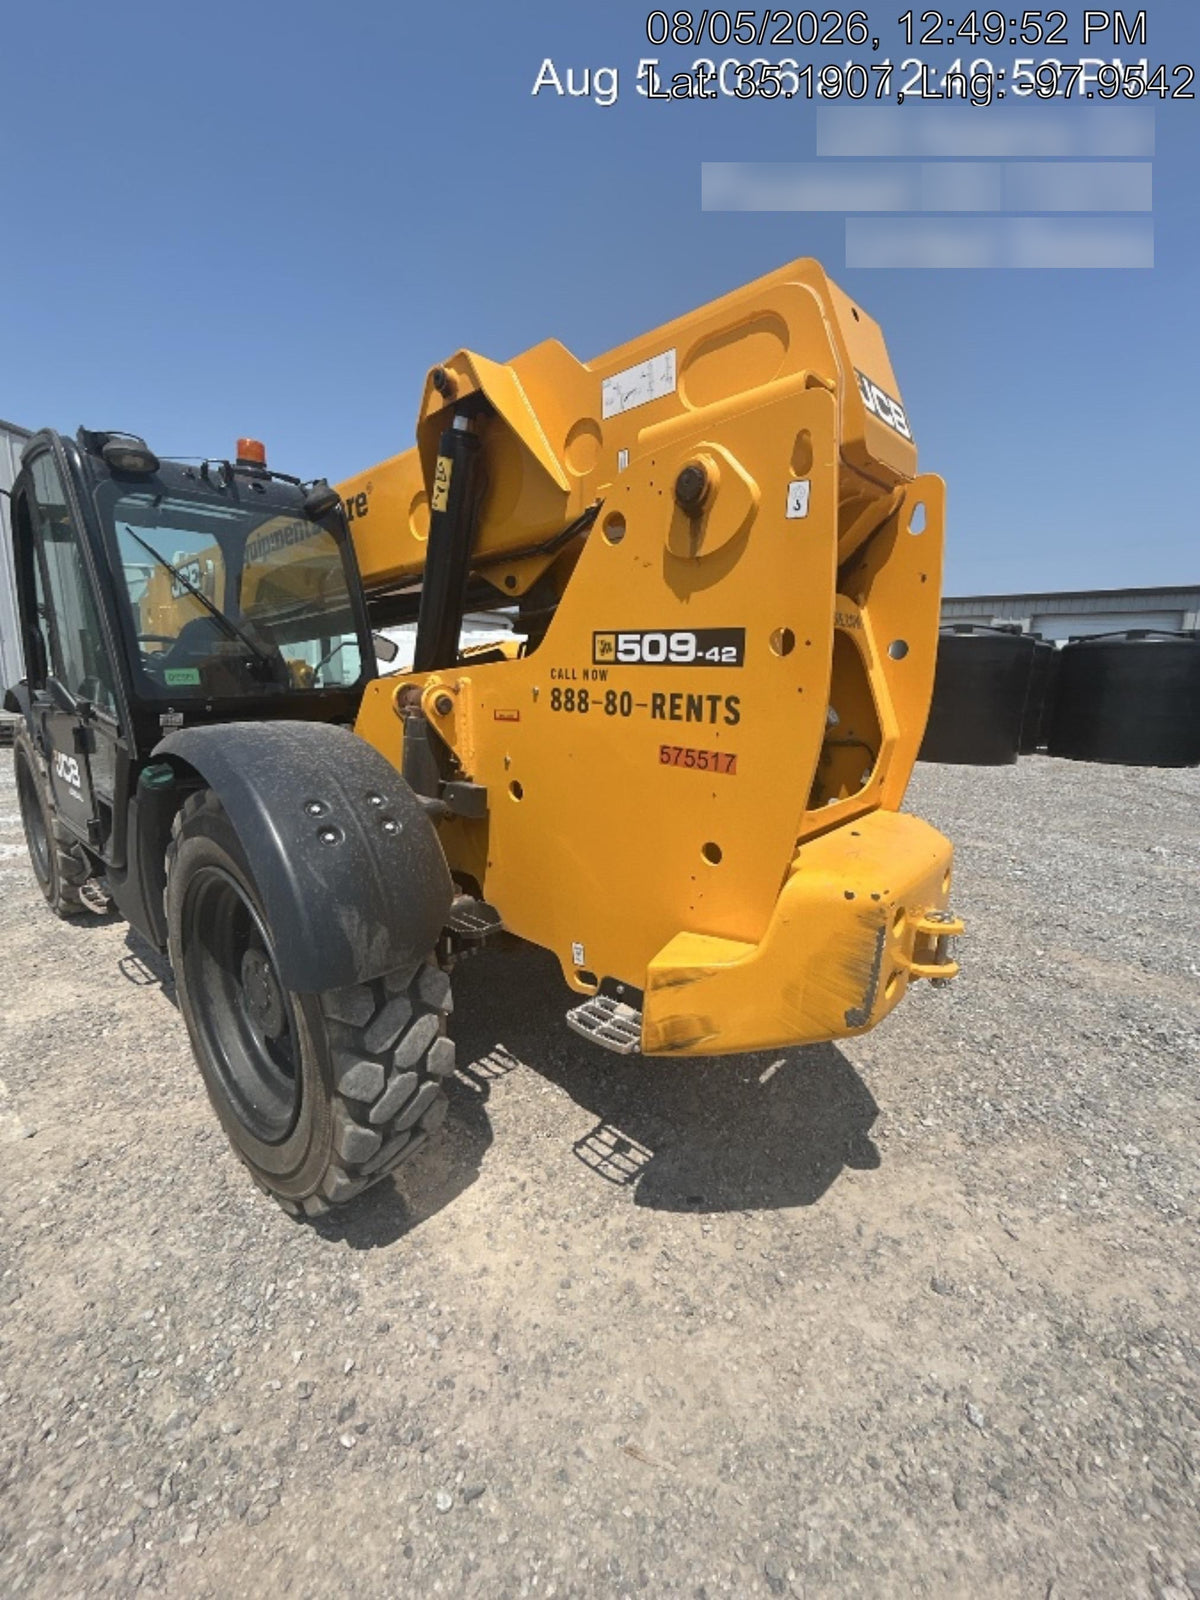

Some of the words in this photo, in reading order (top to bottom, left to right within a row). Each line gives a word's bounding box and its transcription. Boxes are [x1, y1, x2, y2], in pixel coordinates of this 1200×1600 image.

[859, 376, 912, 440] JCB
[616, 632, 737, 663] 509-42
[550, 668, 577, 680] CALL
[582, 669, 608, 682] NOW
[550, 687, 741, 726] 888-80-RENTS
[56, 751, 81, 788] JCB
[659, 745, 737, 774] 575517
